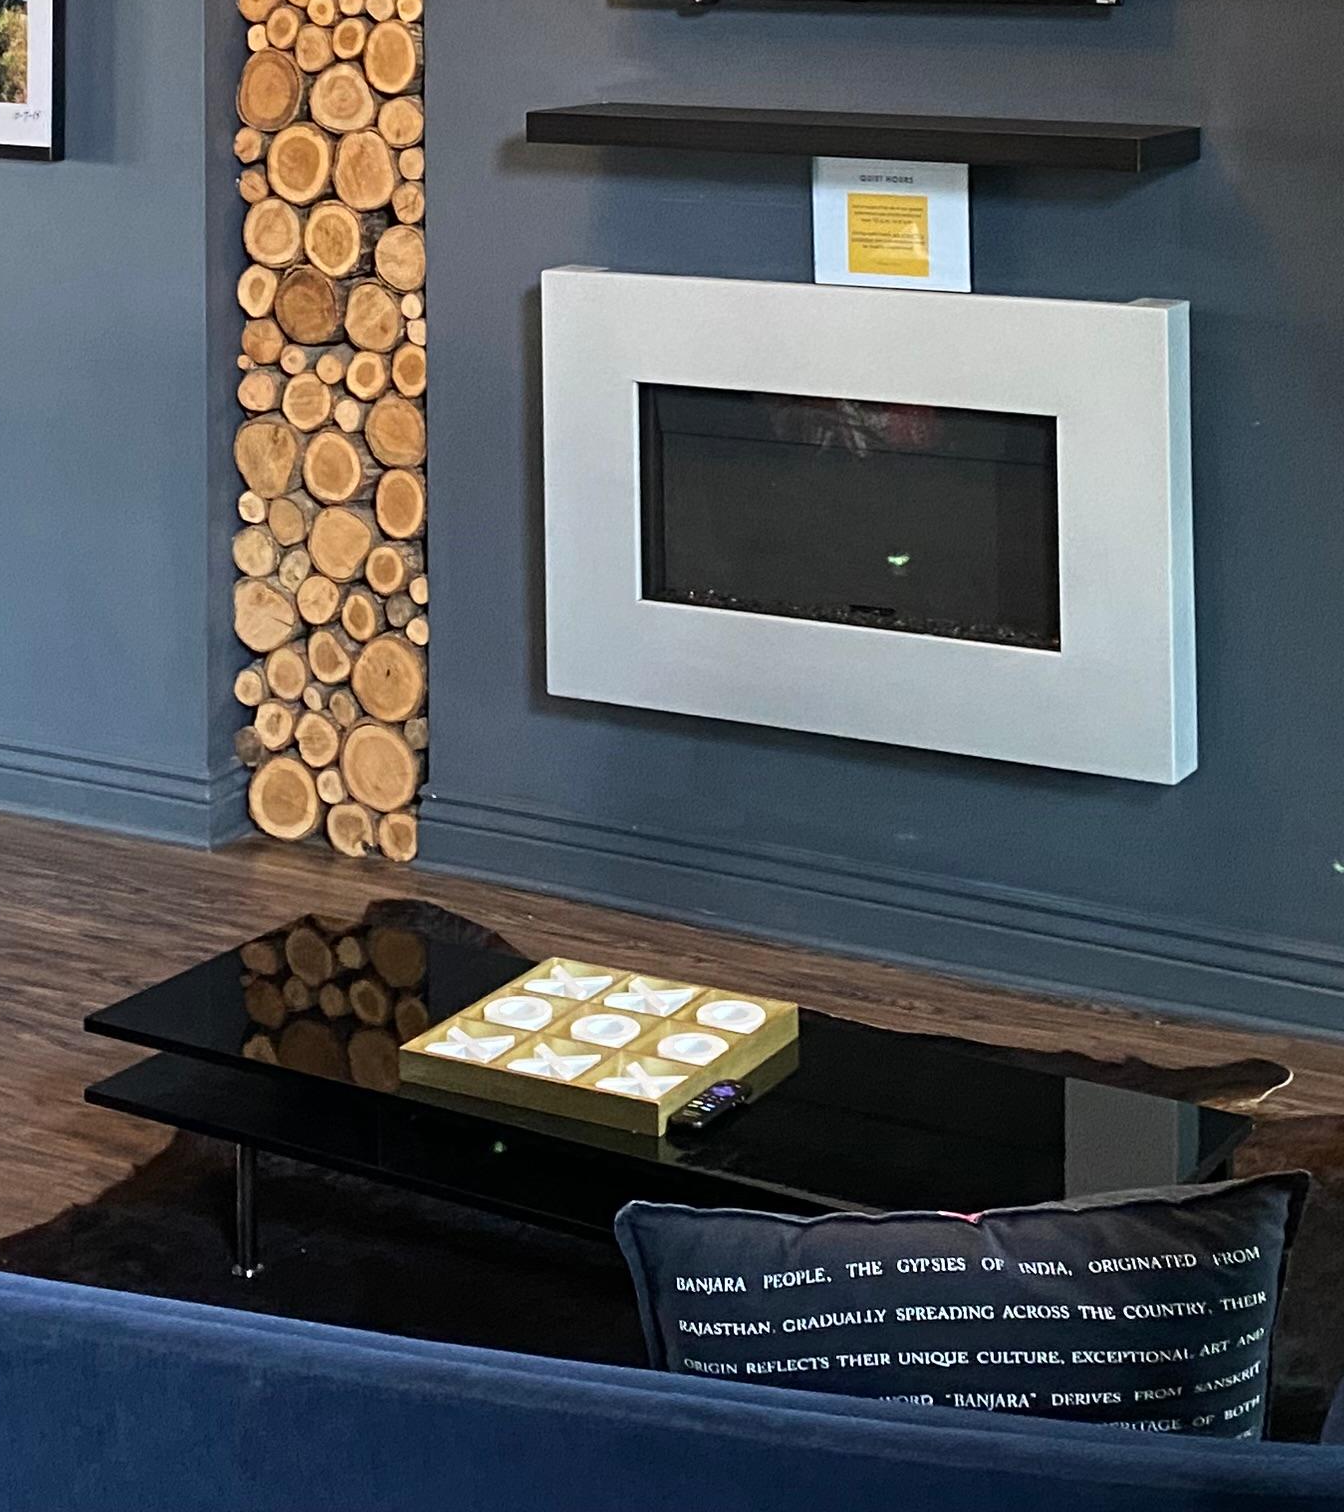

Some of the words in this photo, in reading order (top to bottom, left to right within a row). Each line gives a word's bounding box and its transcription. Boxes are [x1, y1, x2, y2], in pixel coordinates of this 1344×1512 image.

[677, 1277, 746, 1295] BANJARA
[764, 1268, 831, 1289] PEOPLE,
[846, 1261, 882, 1277] THE
[897, 1257, 965, 1273] GYPSIES
[982, 1258, 1004, 1270] OF
[1018, 1262, 1072, 1276] INDIA,
[1088, 1254, 1196, 1273] ORIGINATED
[1213, 1246, 1260, 1266] FROM
[783, 1309, 886, 1332] GRADUALLY
[896, 1306, 994, 1321] SPREADING
[1003, 1305, 1069, 1319] ACROSS
[1078, 1305, 1115, 1319] THE
[1220, 1291, 1266, 1310] THEIR
[684, 1359, 737, 1376] ORIGIN
[747, 1357, 829, 1373] REFLECTS
[836, 1353, 890, 1367] THEIR
[898, 1352, 969, 1367] UNIQUE
[977, 1351, 1064, 1364] CULTURE,
[1200, 1341, 1229, 1356] ART
[1236, 1328, 1264, 1347] AND
[1052, 1393, 1121, 1406] DERIVES
[1135, 1387, 1181, 1401] FROM
[1196, 1360, 1261, 1390] SANSKRIT
[1194, 1415, 1214, 1425] OF
[1225, 1395, 1260, 1419] BOTH
